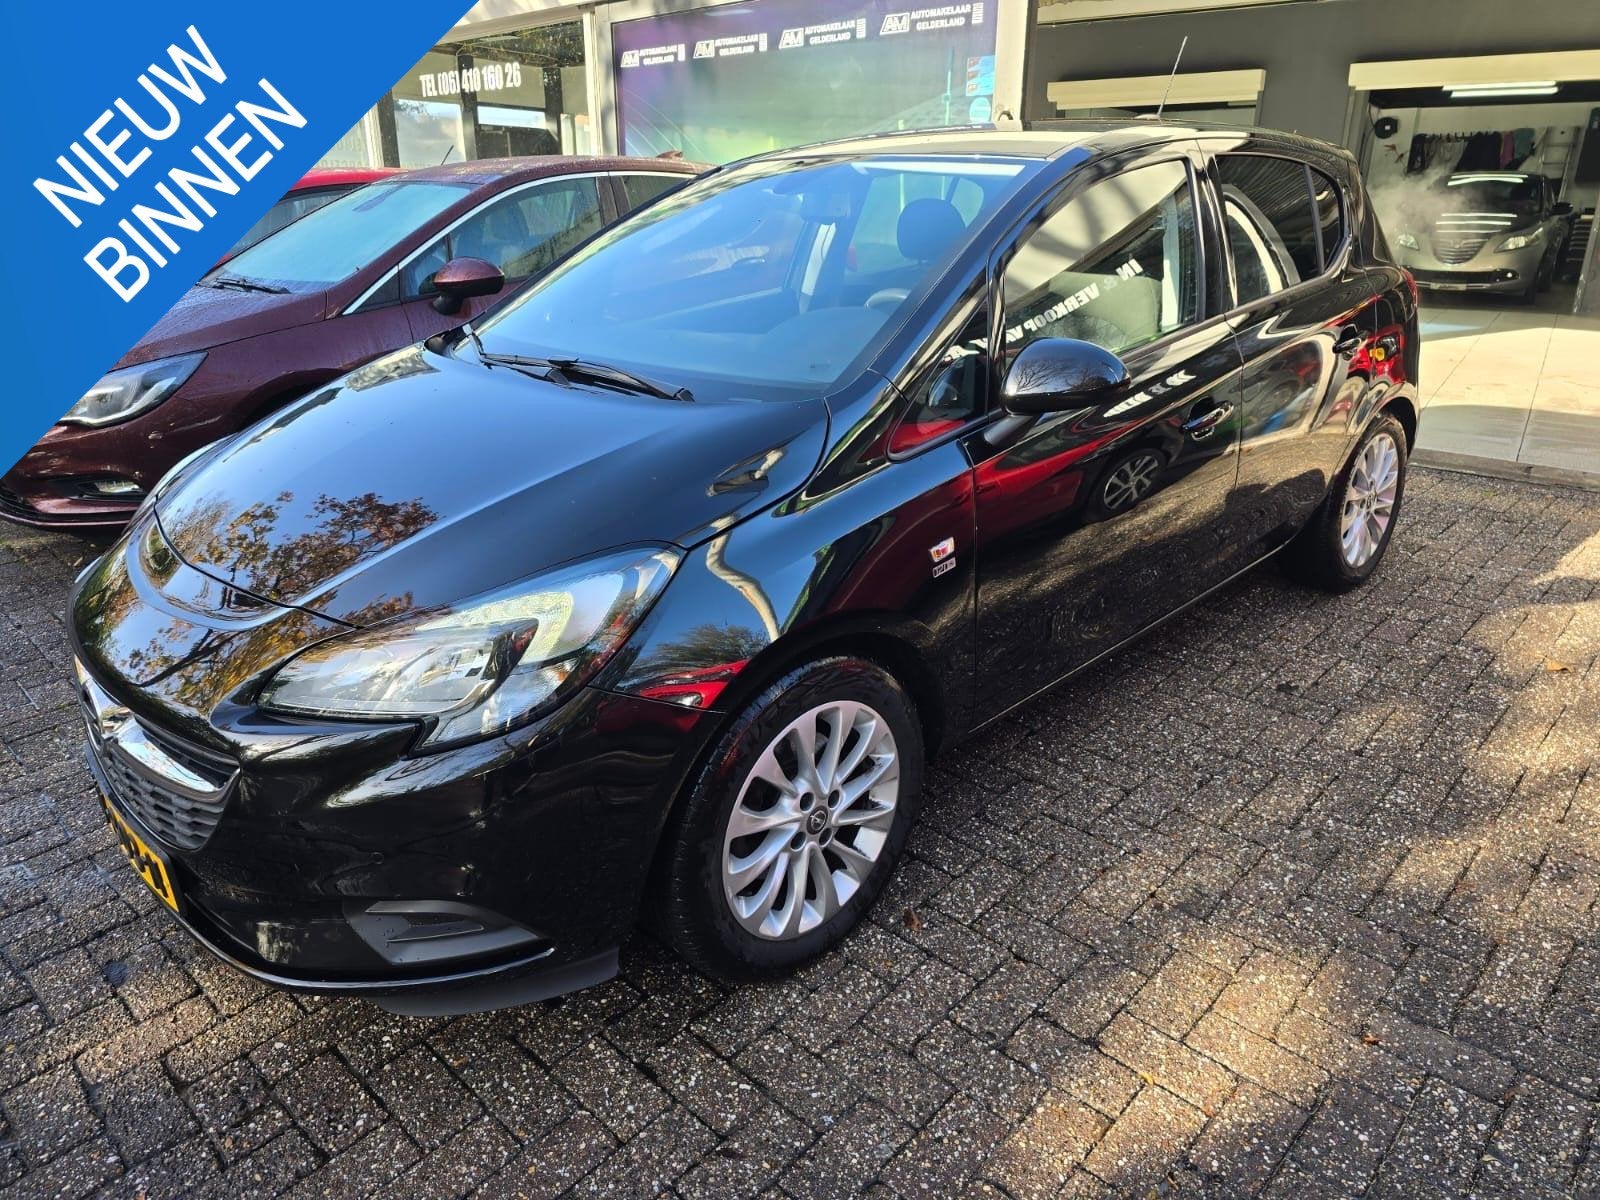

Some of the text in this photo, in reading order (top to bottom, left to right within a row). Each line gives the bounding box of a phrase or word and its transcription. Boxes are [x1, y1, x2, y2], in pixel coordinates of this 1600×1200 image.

[882, 4, 972, 34] AM AUTOMAKELAAR
[916, 16, 966, 31] GELDERLAND
[804, 20, 856, 35] AUTOMAKELAAR
[809, 31, 852, 45] GELDERLAND
[419, 73, 438, 97] TEL
[461, 67, 481, 93] 410
[481, 64, 504, 91] 160
[504, 61, 522, 88] 26
